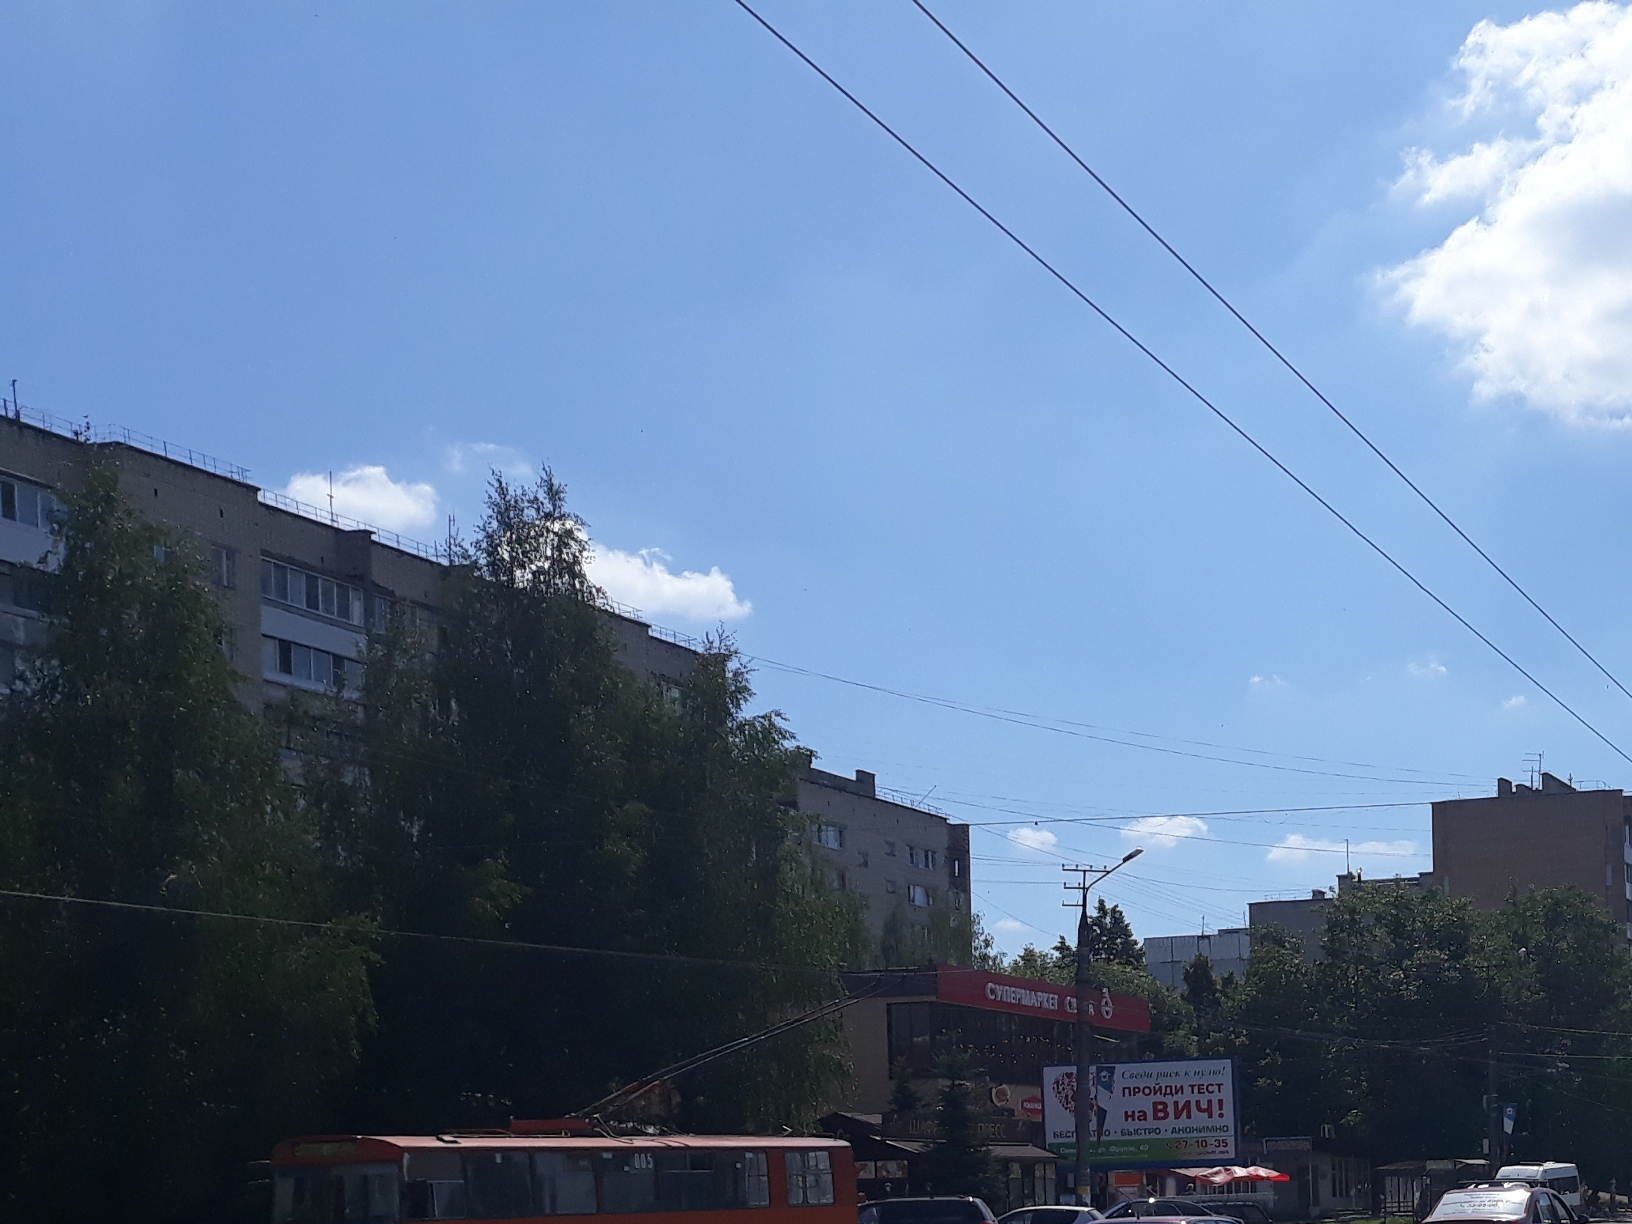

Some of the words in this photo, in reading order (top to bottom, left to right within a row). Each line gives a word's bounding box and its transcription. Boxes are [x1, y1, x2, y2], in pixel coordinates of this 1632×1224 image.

[1122, 1082, 1184, 1098] ПРОЙДИ
[1188, 1083, 1223, 1095] ТЕСТ
[1124, 1109, 1147, 1122] на
[1152, 1098, 1224, 1121] ВИЧ!
[1120, 1127, 1161, 1137] БЫСТРО
[1171, 1125, 1229, 1135] АНОНИМНО
